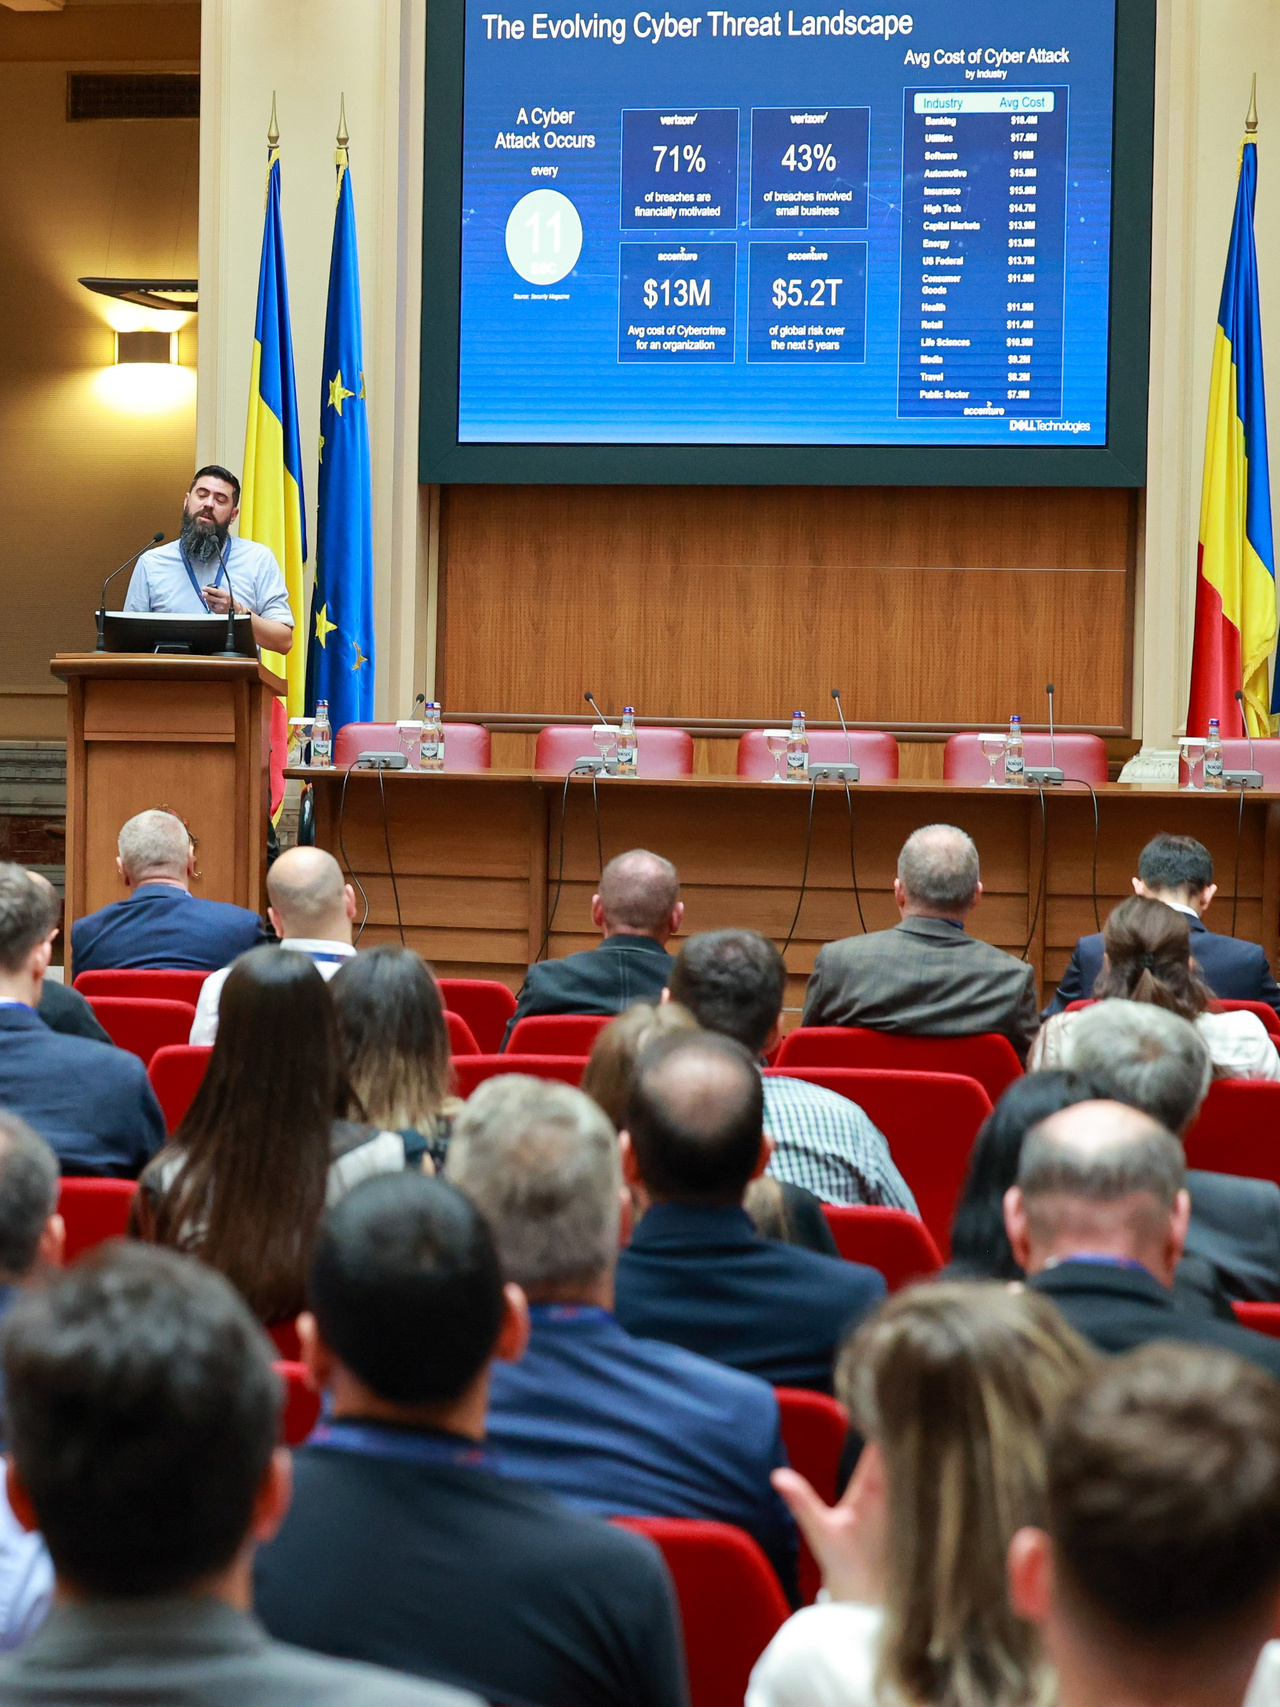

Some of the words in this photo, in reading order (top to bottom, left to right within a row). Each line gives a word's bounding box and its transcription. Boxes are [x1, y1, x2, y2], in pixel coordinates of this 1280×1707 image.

[482, 14, 524, 39] The
[533, 13, 626, 44] Evolving
[634, 12, 702, 44] Cyber
[707, 11, 781, 36] Threat
[788, 10, 913, 40] Landscape
[904, 50, 930, 68] Avg
[934, 49, 965, 64] Cost
[968, 48, 982, 64] of
[984, 48, 1025, 66] Cyber
[1027, 48, 1069, 63] Attack
[966, 70, 975, 80] by
[977, 69, 1007, 80] Industry
[924, 98, 962, 110] Industry
[1000, 98, 1018, 110] Avg
[1022, 97, 1044, 107] Cost
[516, 108, 528, 124] A
[531, 108, 575, 128] Cyber
[660, 113, 698, 125] verizon
[790, 112, 828, 124] verizon
[926, 117, 956, 126] Banking
[495, 132, 540, 148] Attack
[544, 132, 595, 148] Occurs
[925, 134, 953, 142] Utilities
[653, 145, 706, 172] 71%
[782, 144, 836, 171] 43%
[925, 152, 958, 160] Software
[531, 167, 558, 178] every
[924, 169, 967, 178] Automotive
[764, 191, 773, 201] of
[774, 191, 814, 201] breaches
[816, 191, 852, 201] involved
[924, 187, 961, 195] Insurance
[645, 192, 654, 202] of
[655, 192, 694, 202] breaches
[696, 194, 711, 202] are
[635, 206, 677, 219] financially
[679, 206, 720, 216] motivated
[776, 206, 799, 216] small
[801, 206, 839, 216] business
[924, 204, 941, 214] High
[943, 204, 961, 212] Tech
[1009, 204, 1036, 213] $14.7M
[923, 222, 949, 232] Capital
[951, 221, 980, 230] Markets
[526, 212, 560, 253] 11
[923, 239, 950, 249] Energy
[658, 247, 698, 261] accenture
[788, 246, 828, 260] accenture
[923, 257, 934, 265] US
[935, 256, 963, 265] Federal
[1008, 256, 1034, 265] $13.7M
[922, 274, 961, 283] Consumer
[644, 278, 710, 309] $13M
[772, 278, 843, 309] $5.2T
[922, 286, 947, 294] Goods
[922, 303, 946, 311] Health
[921, 320, 943, 329] Retail
[628, 325, 645, 337] Avg
[646, 326, 665, 335] cost
[666, 325, 676, 335] of
[677, 325, 726, 337] Cybercrime
[769, 325, 779, 335] of
[780, 325, 806, 337] global
[808, 325, 824, 335] risk
[825, 327, 845, 335] over
[636, 340, 648, 350] for
[662, 340, 715, 351] organization
[771, 340, 785, 350] the
[787, 340, 806, 350] next
[808, 340, 814, 350] 5
[816, 342, 840, 352] years
[921, 338, 935, 346] Life
[936, 338, 970, 346] Sciences
[920, 355, 943, 364] Media
[920, 372, 944, 381] Travel
[920, 390, 943, 399] Public
[944, 390, 970, 399] Sector
[964, 401, 1004, 415] accenture
